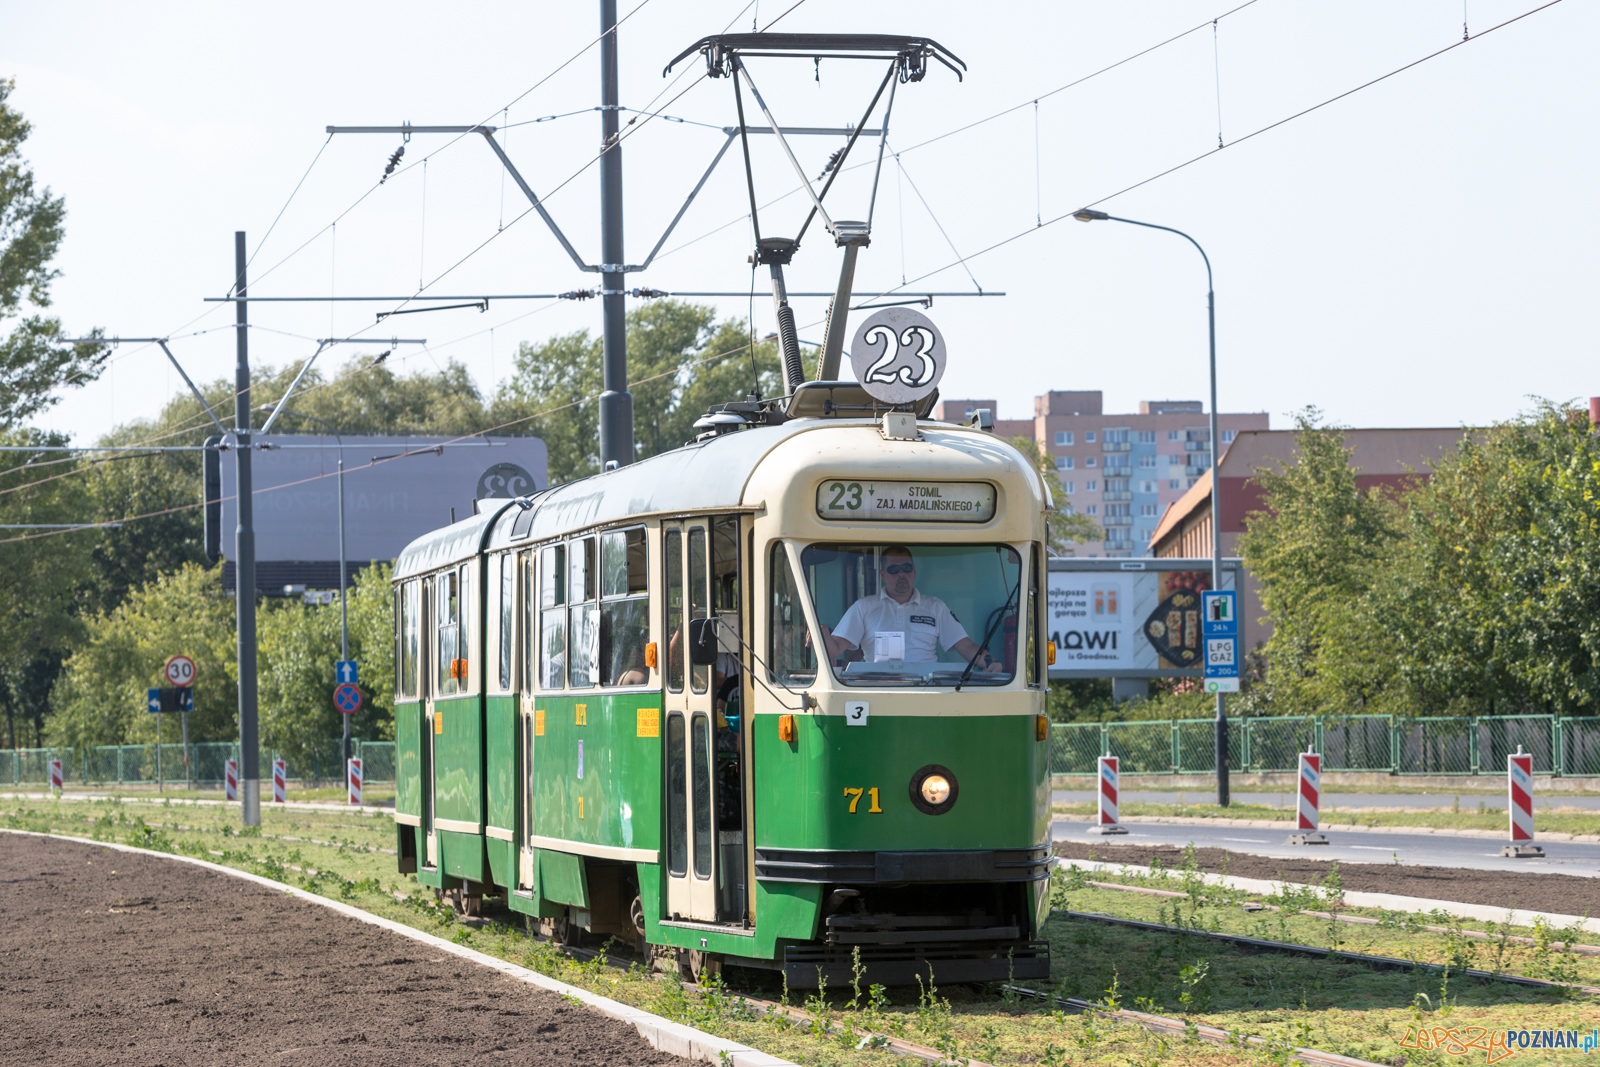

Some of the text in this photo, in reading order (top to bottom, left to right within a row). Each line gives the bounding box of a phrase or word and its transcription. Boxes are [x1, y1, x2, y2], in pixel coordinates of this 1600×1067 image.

[864, 324, 936, 388] 23
[828, 482, 863, 511] 23
[908, 486, 943, 498] STOMIL
[876, 498, 973, 511] ZAJ. MADALIŃSKIEGO
[1048, 587, 1087, 598] ajlepsza
[1048, 599, 1073, 609] cyzja
[1213, 624, 1221, 632] 24
[1210, 642, 1232, 652] LPG
[1210, 653, 1232, 662] GAZ
[170, 663, 191, 679] 30
[1218, 667, 1232, 675] 200
[851, 706, 864, 720] 3
[843, 787, 883, 814] 71
